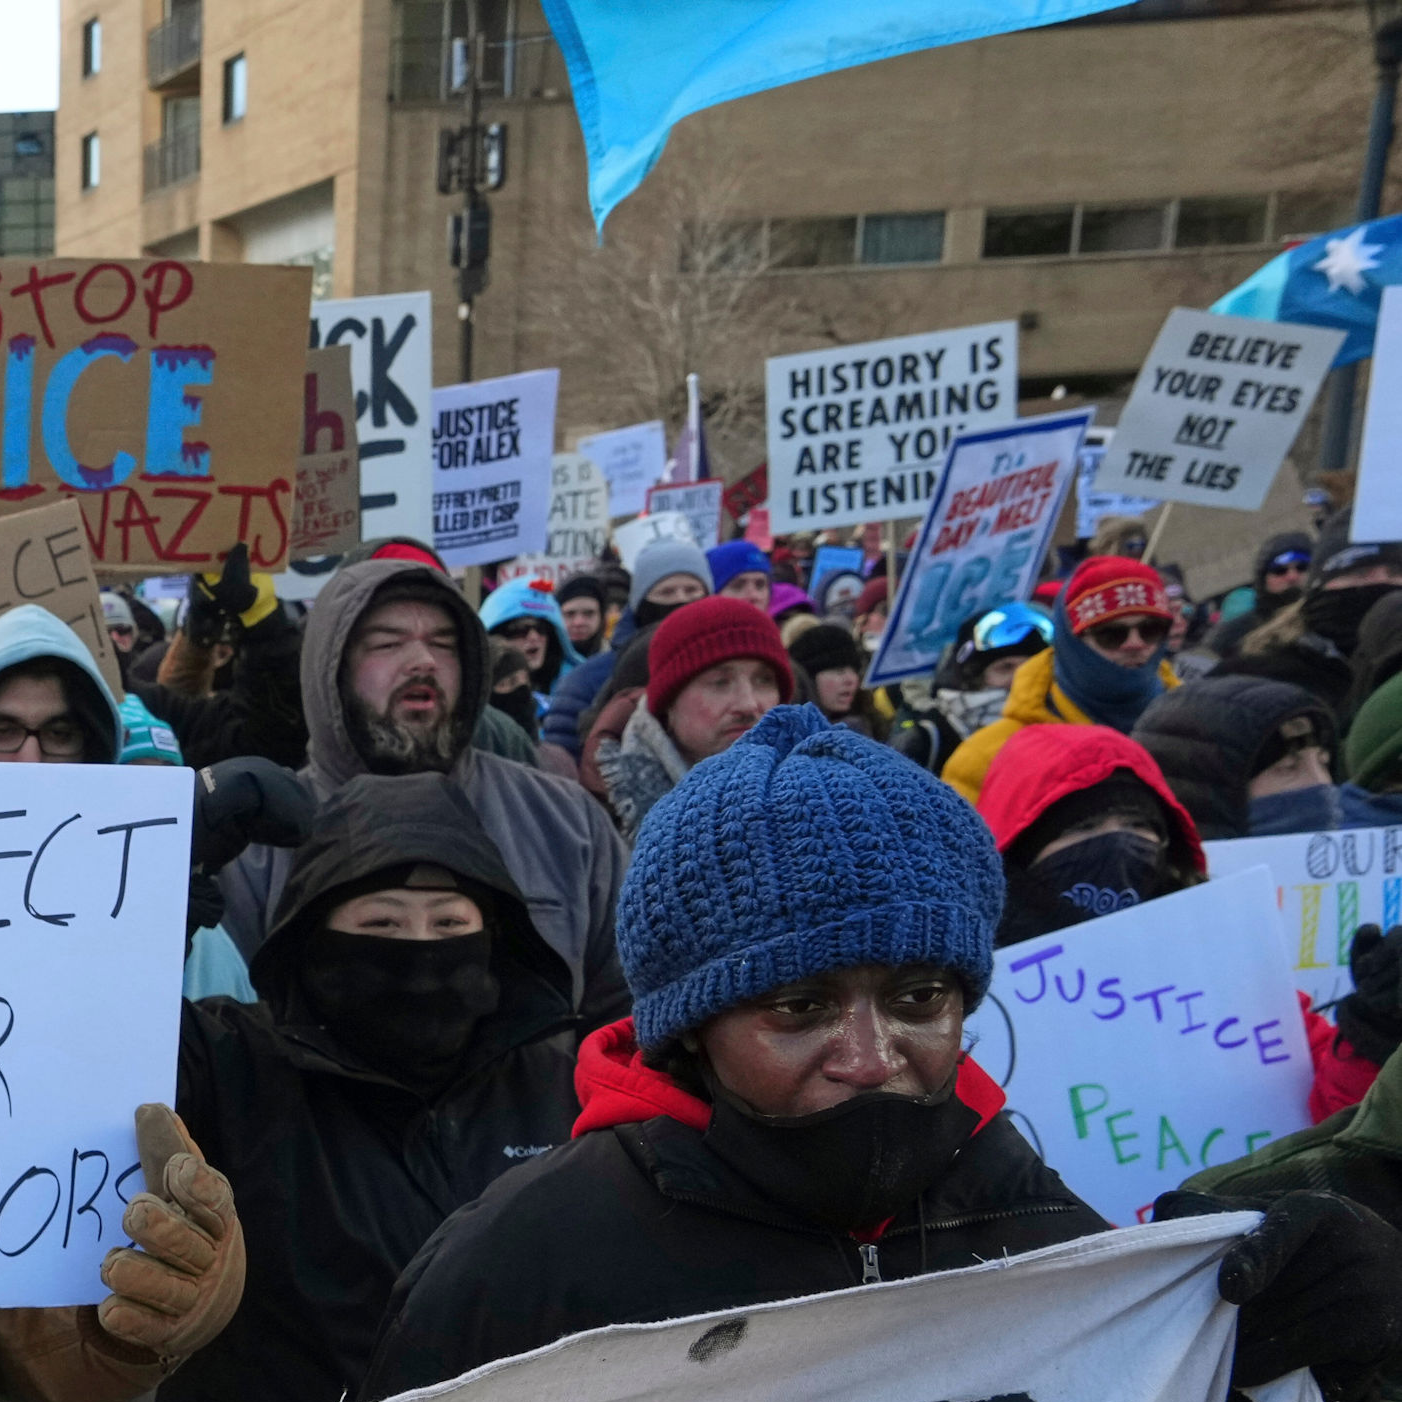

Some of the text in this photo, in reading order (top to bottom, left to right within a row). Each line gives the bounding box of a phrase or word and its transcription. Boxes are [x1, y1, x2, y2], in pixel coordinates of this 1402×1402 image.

[790, 338, 1002, 399] HISTORY IS
[1187, 331, 1302, 370] BELIEVE
[2, 333, 218, 491] ICE
[780, 380, 999, 439] SCREAMING
[1152, 366, 1302, 414] YOUR EYES
[432, 397, 520, 440] JUSTICE
[1176, 414, 1236, 444] NOT
[472, 428, 520, 466] ALEX
[796, 440, 862, 476] ARE
[790, 471, 937, 518] LISTENIN
[946, 460, 1060, 522] BEAUTIFUL
[1124, 451, 1175, 481] THE
[1182, 459, 1243, 492] LIES
[66, 478, 291, 567] NAZIS
[931, 516, 981, 556] DAY
[988, 493, 1051, 537] MELT
[1010, 944, 1291, 1065] JUSTICE
